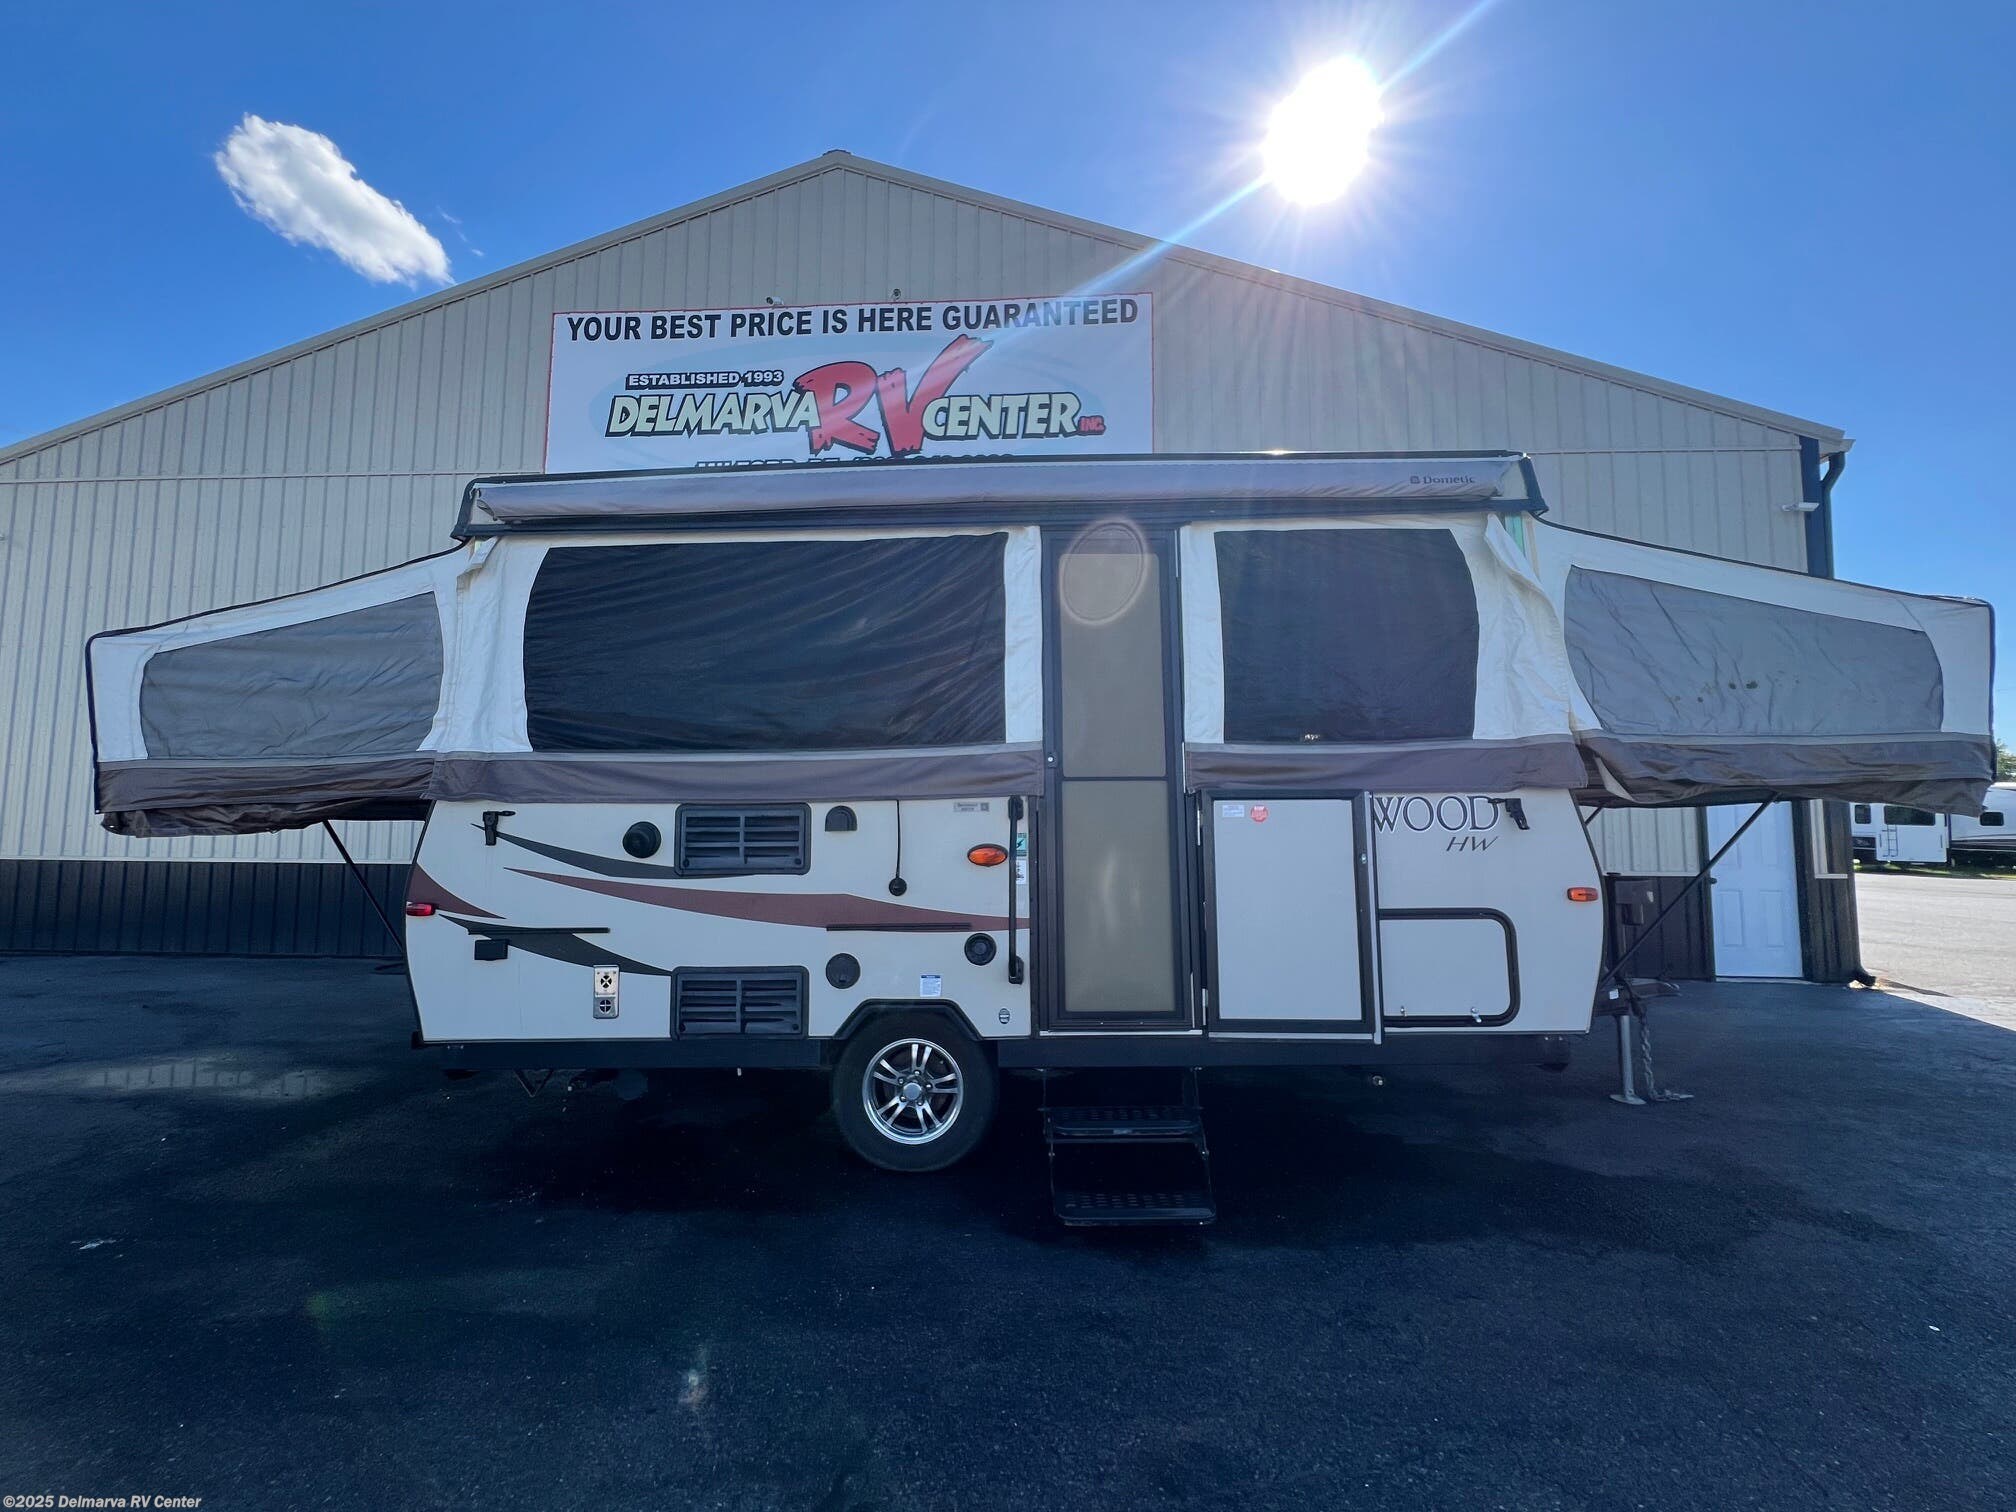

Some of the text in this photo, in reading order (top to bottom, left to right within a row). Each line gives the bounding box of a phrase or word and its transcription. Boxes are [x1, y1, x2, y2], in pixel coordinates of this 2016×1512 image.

[567, 298, 1139, 341] YOUR BEST PRICE IS HERE GUARANTEED
[627, 370, 784, 387] ESTABLISHED 1993
[606, 390, 823, 437] DELMARVA
[792, 333, 995, 458] RV
[921, 392, 1082, 440] CENTER
[1423, 475, 1476, 485] Dometic
[1445, 835, 1499, 852] HW
